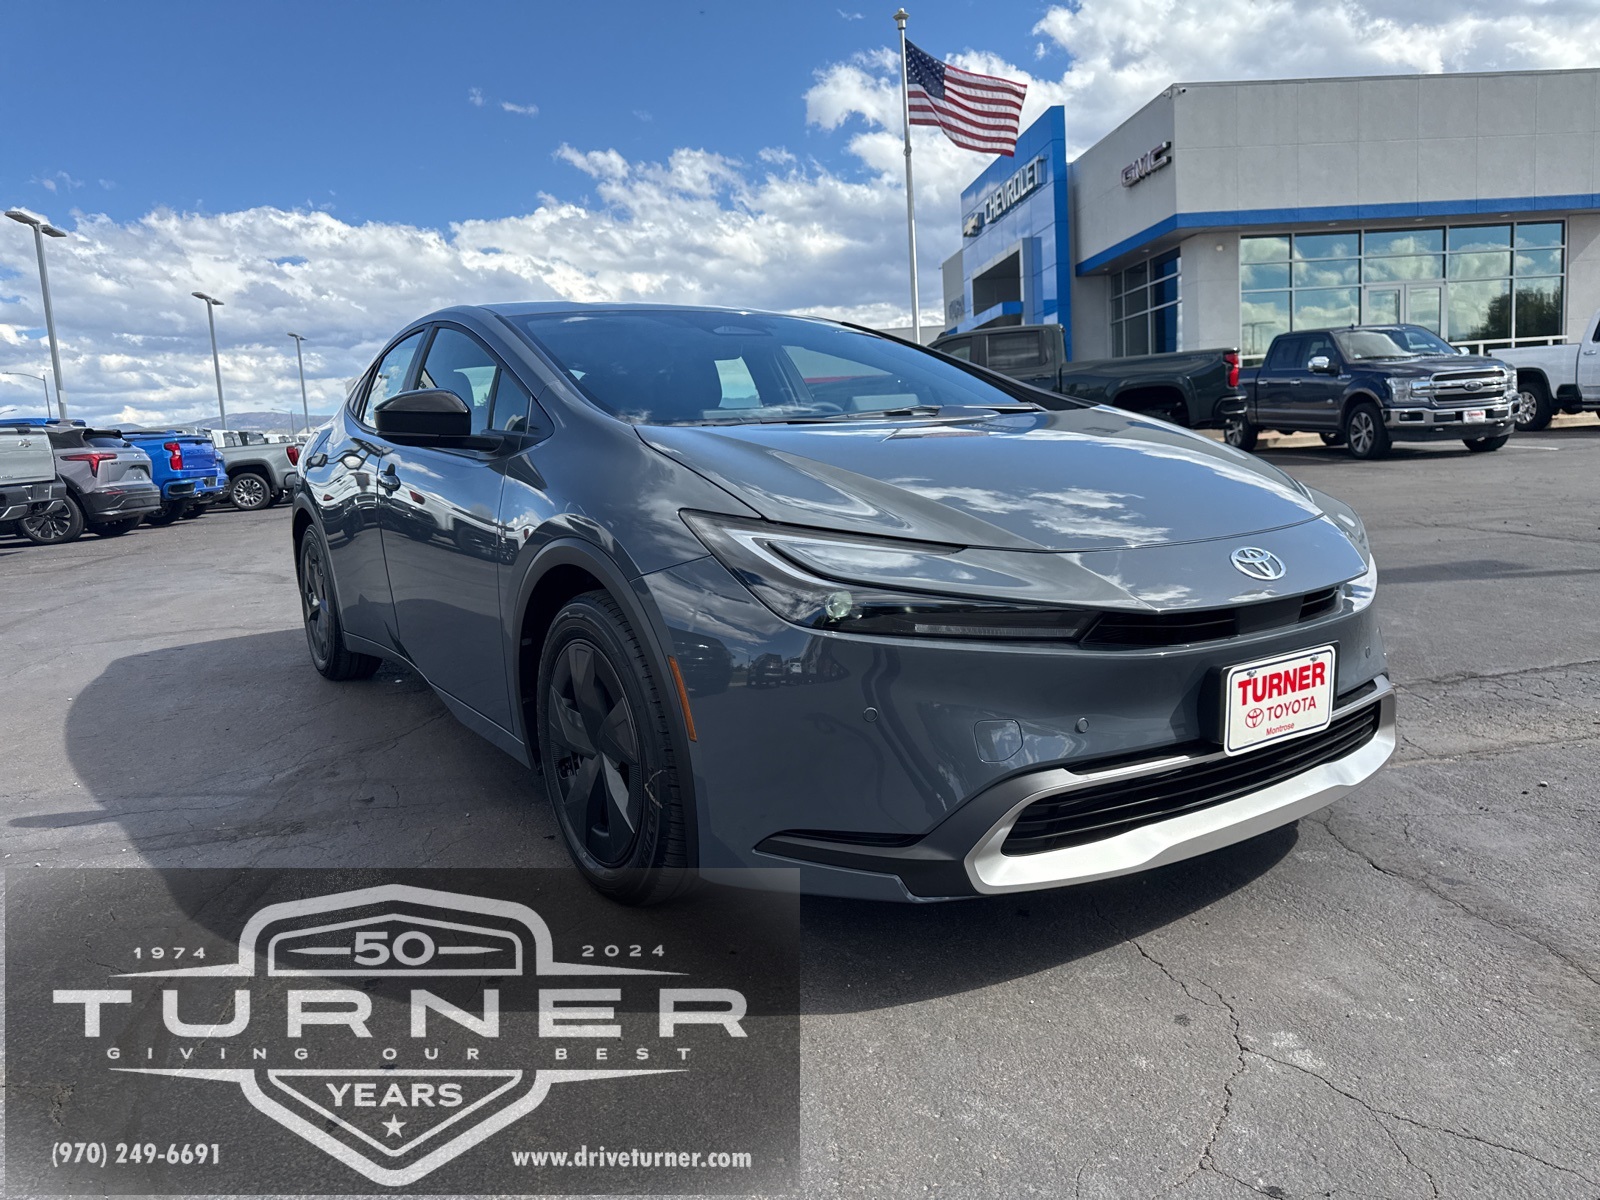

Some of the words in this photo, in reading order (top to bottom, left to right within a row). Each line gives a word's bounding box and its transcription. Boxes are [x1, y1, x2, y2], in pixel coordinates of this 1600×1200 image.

[1121, 141, 1172, 188] GMC
[983, 155, 1046, 225] CHEVROLET
[1238, 661, 1326, 706] TURNER
[1266, 695, 1317, 721] TOYOTA
[1266, 722, 1295, 736] Montrose
